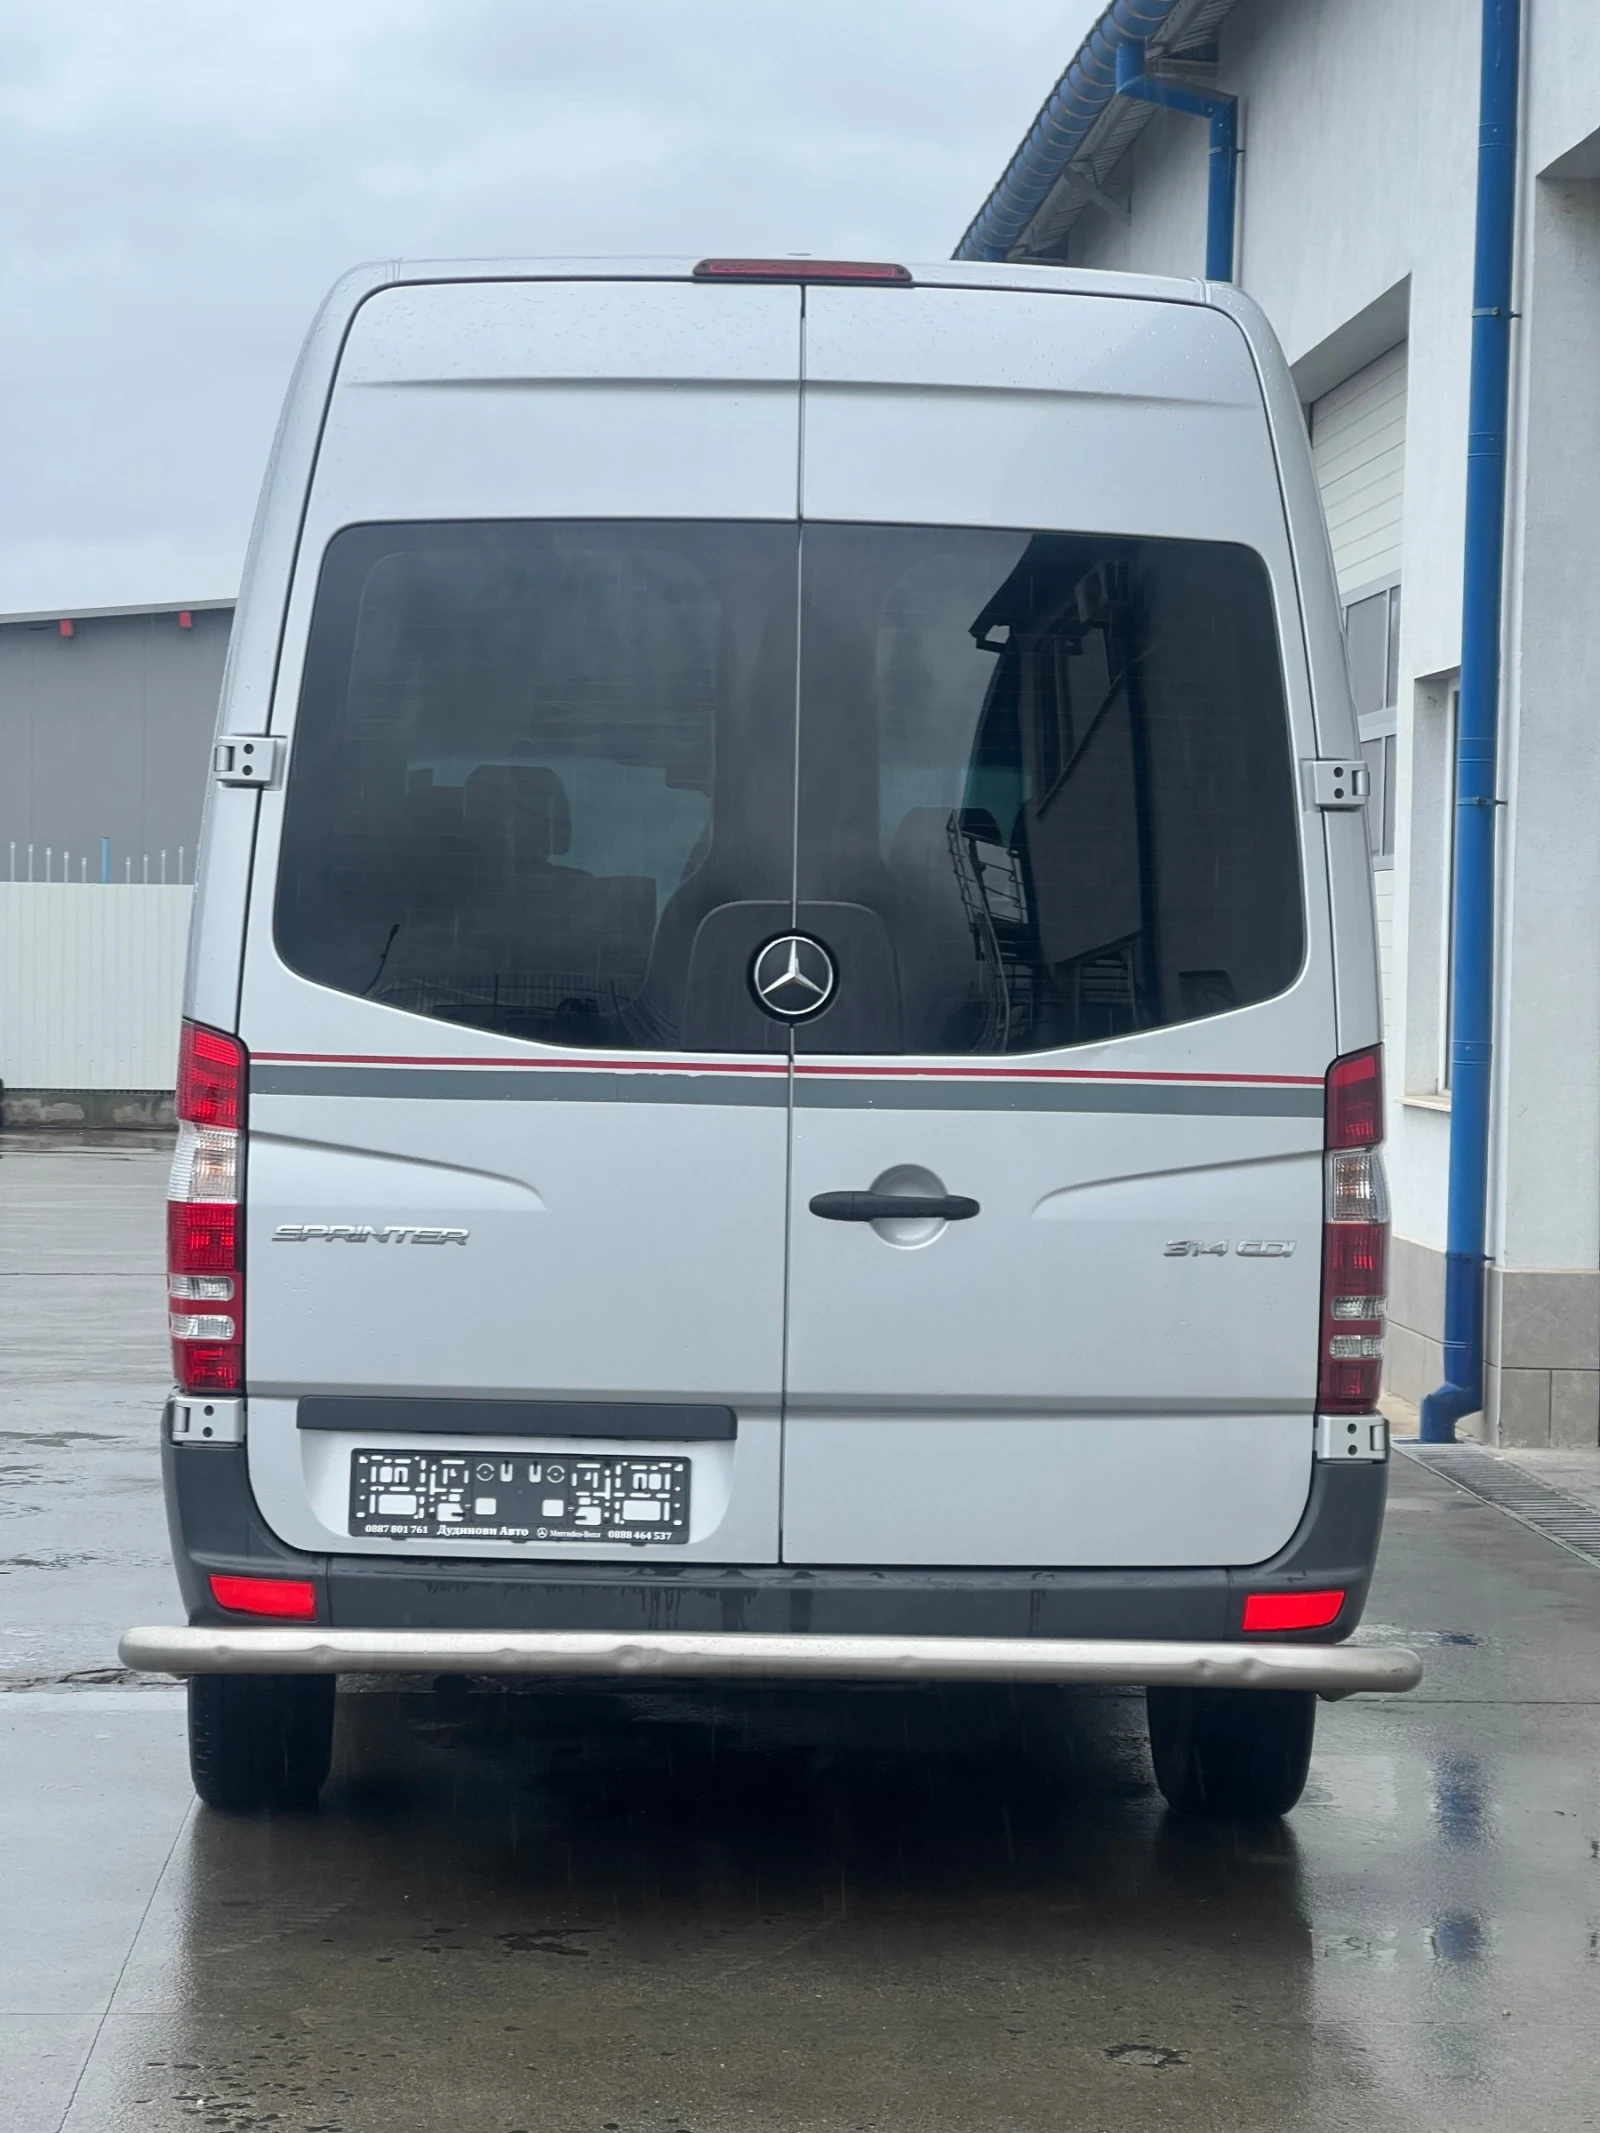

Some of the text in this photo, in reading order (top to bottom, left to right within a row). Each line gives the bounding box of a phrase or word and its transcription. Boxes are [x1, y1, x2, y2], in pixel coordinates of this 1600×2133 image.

[272, 1224, 470, 1246] SPRINTER
[1163, 1239, 1297, 1258] 314 CDI
[364, 1524, 429, 1535] 0887 801 761
[436, 1524, 530, 1537] Дудинови Авто
[549, 1530, 602, 1539] Mercedes-Benz
[607, 1530, 673, 1541] 0888 464 537
